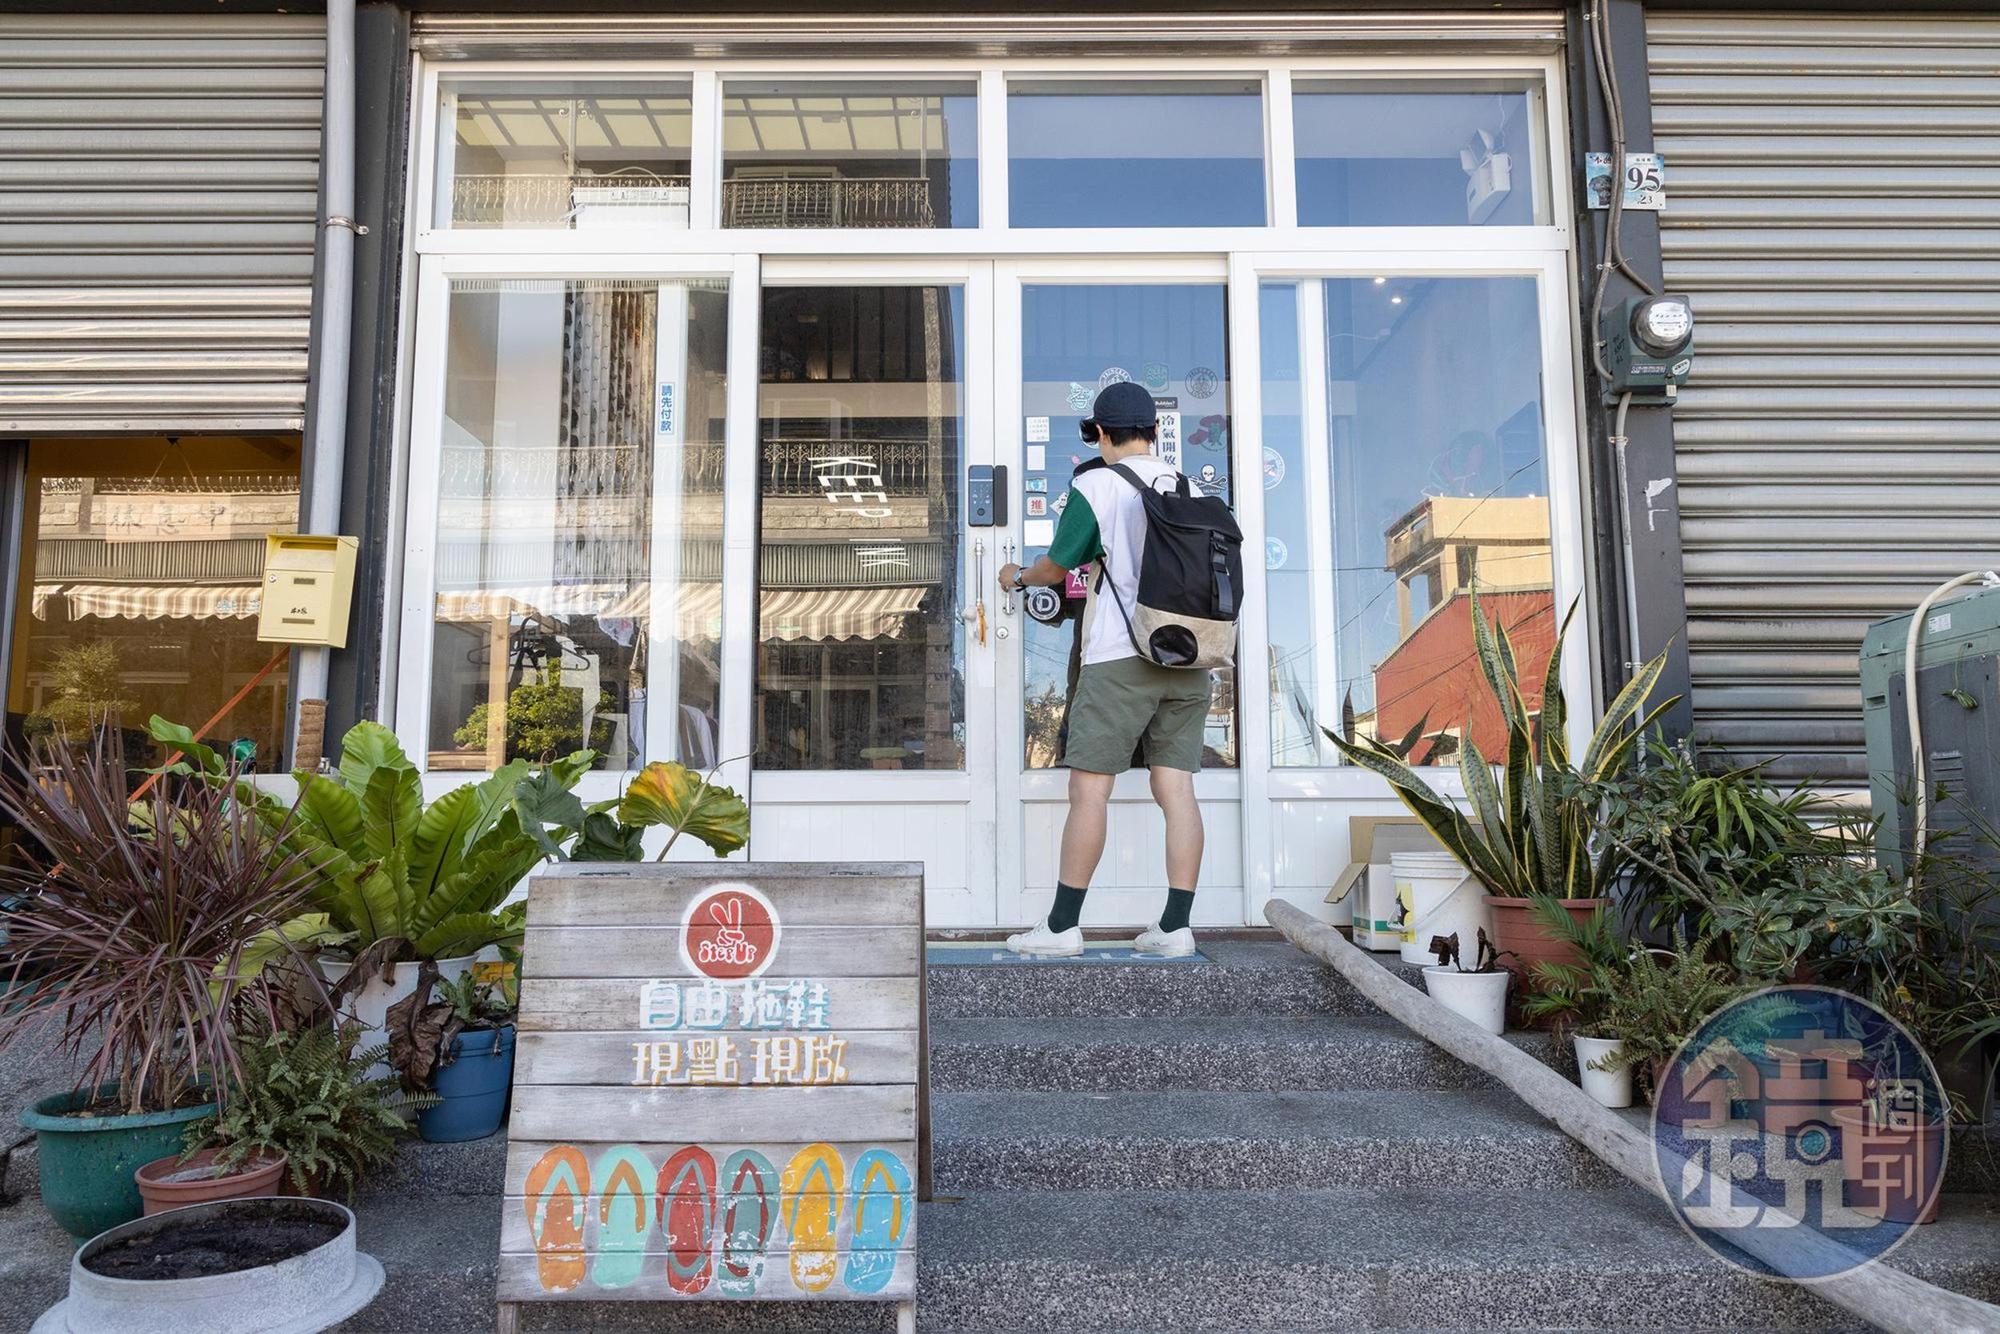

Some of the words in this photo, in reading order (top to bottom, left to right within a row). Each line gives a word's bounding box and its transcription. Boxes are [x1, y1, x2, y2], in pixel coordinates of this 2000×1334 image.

[1628, 167, 1660, 191] 95
[661, 385, 672, 431] 請先付款
[1162, 415, 1176, 466] 冷氣開放
[808, 456, 893, 518] KEEP
[1031, 499, 1043, 510] 推
